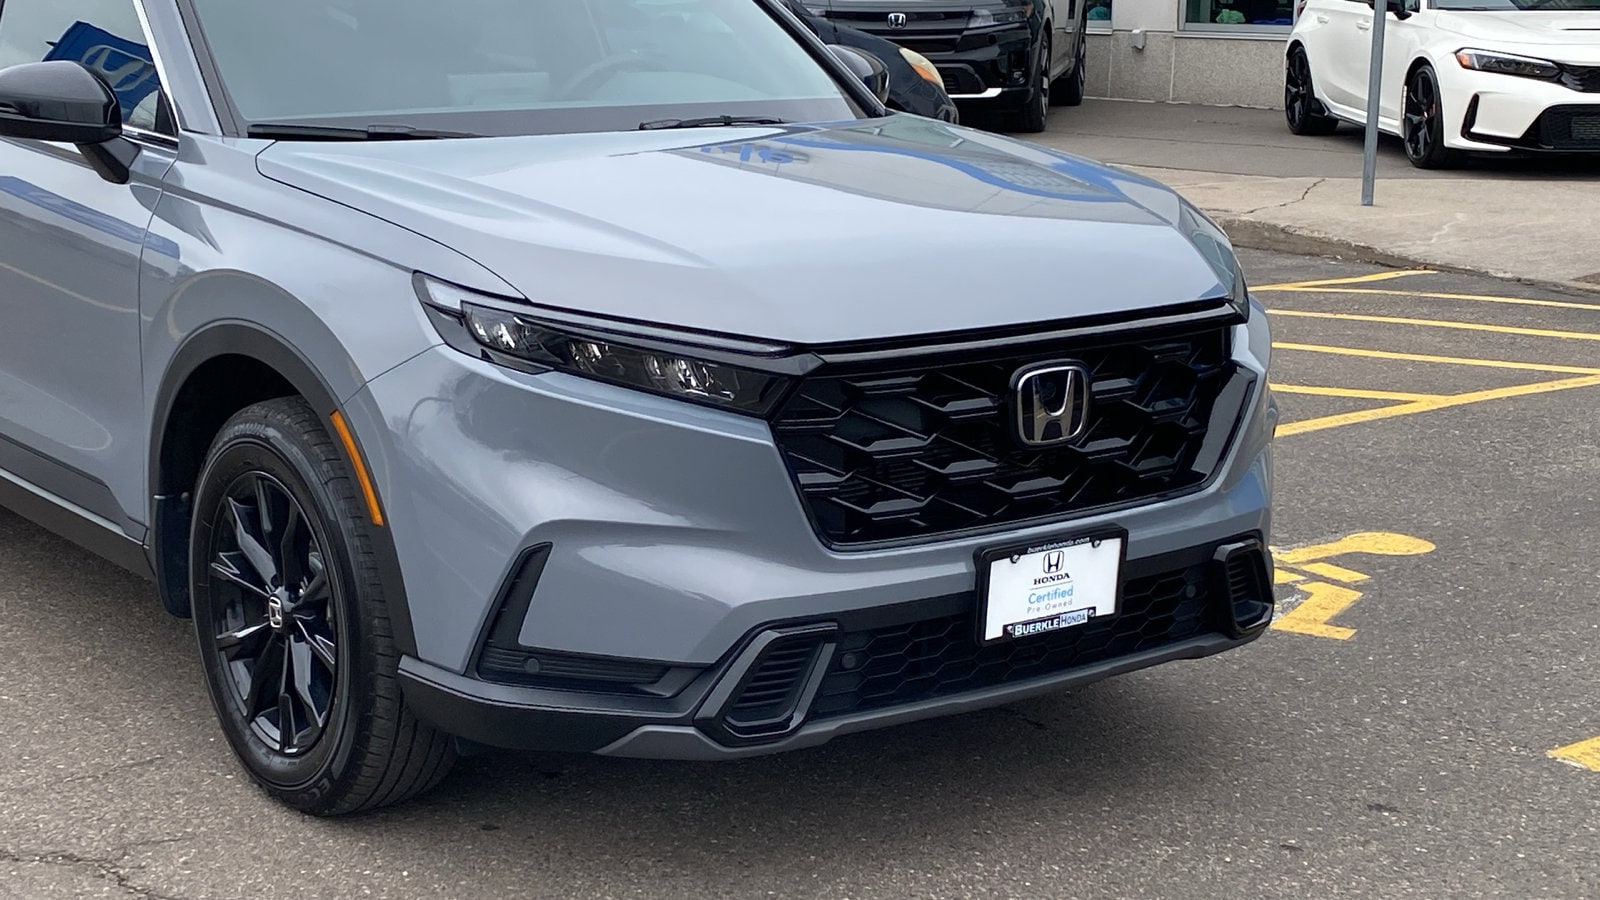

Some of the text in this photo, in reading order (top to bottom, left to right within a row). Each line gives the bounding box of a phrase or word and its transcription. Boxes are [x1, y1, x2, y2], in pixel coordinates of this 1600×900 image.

[1033, 573, 1071, 586] HONDA
[1028, 585, 1074, 605] Certified
[1027, 599, 1073, 615] Pre Owned
[1014, 613, 1086, 636] BUERKLE HONDA
